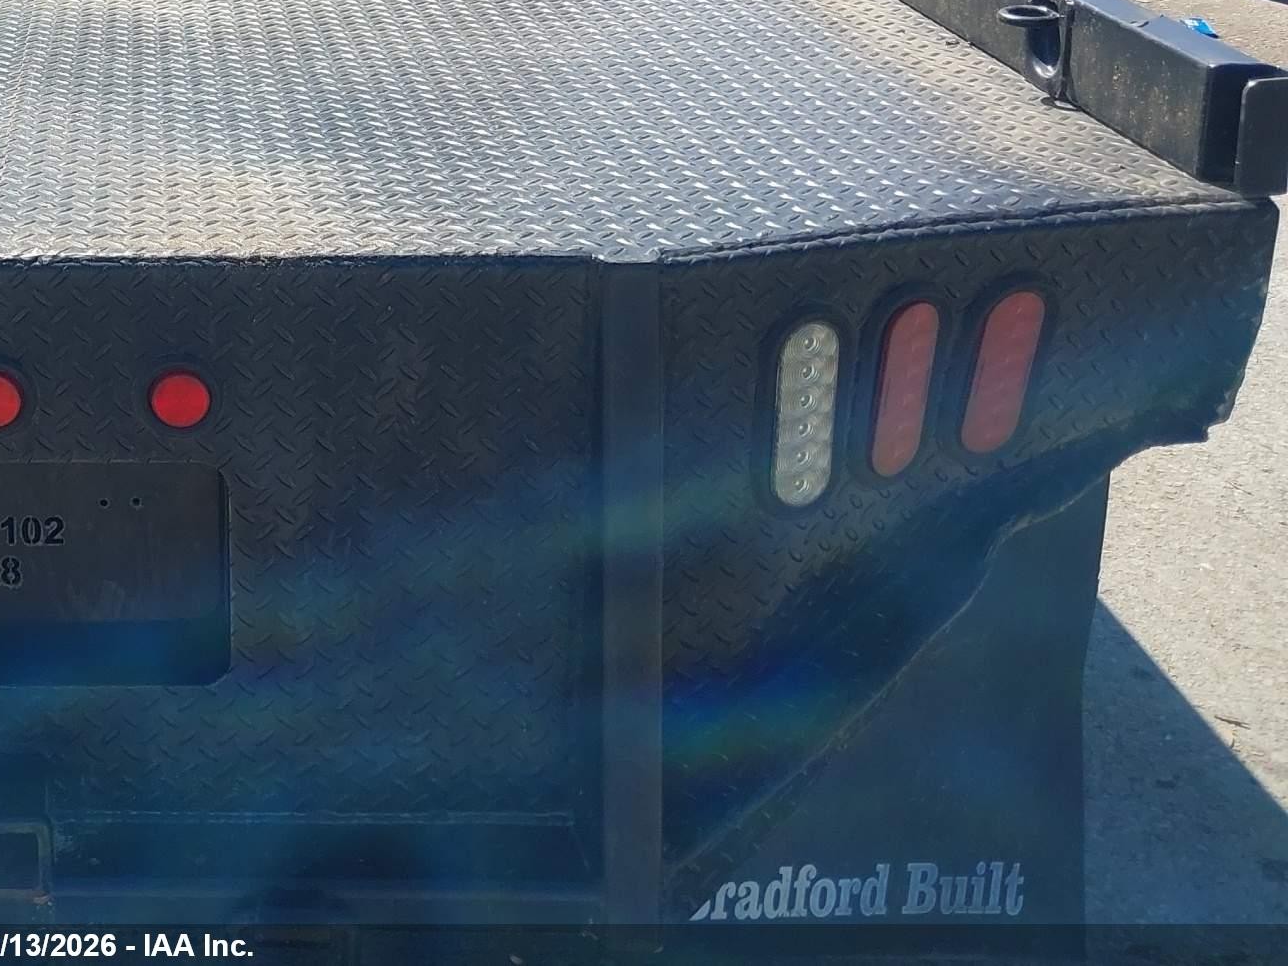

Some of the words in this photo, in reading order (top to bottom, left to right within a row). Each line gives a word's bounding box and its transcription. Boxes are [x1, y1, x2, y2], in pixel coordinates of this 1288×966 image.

[0, 515, 65, 546] 102
[689, 863, 890, 922] radford
[902, 861, 1025, 916] Built
